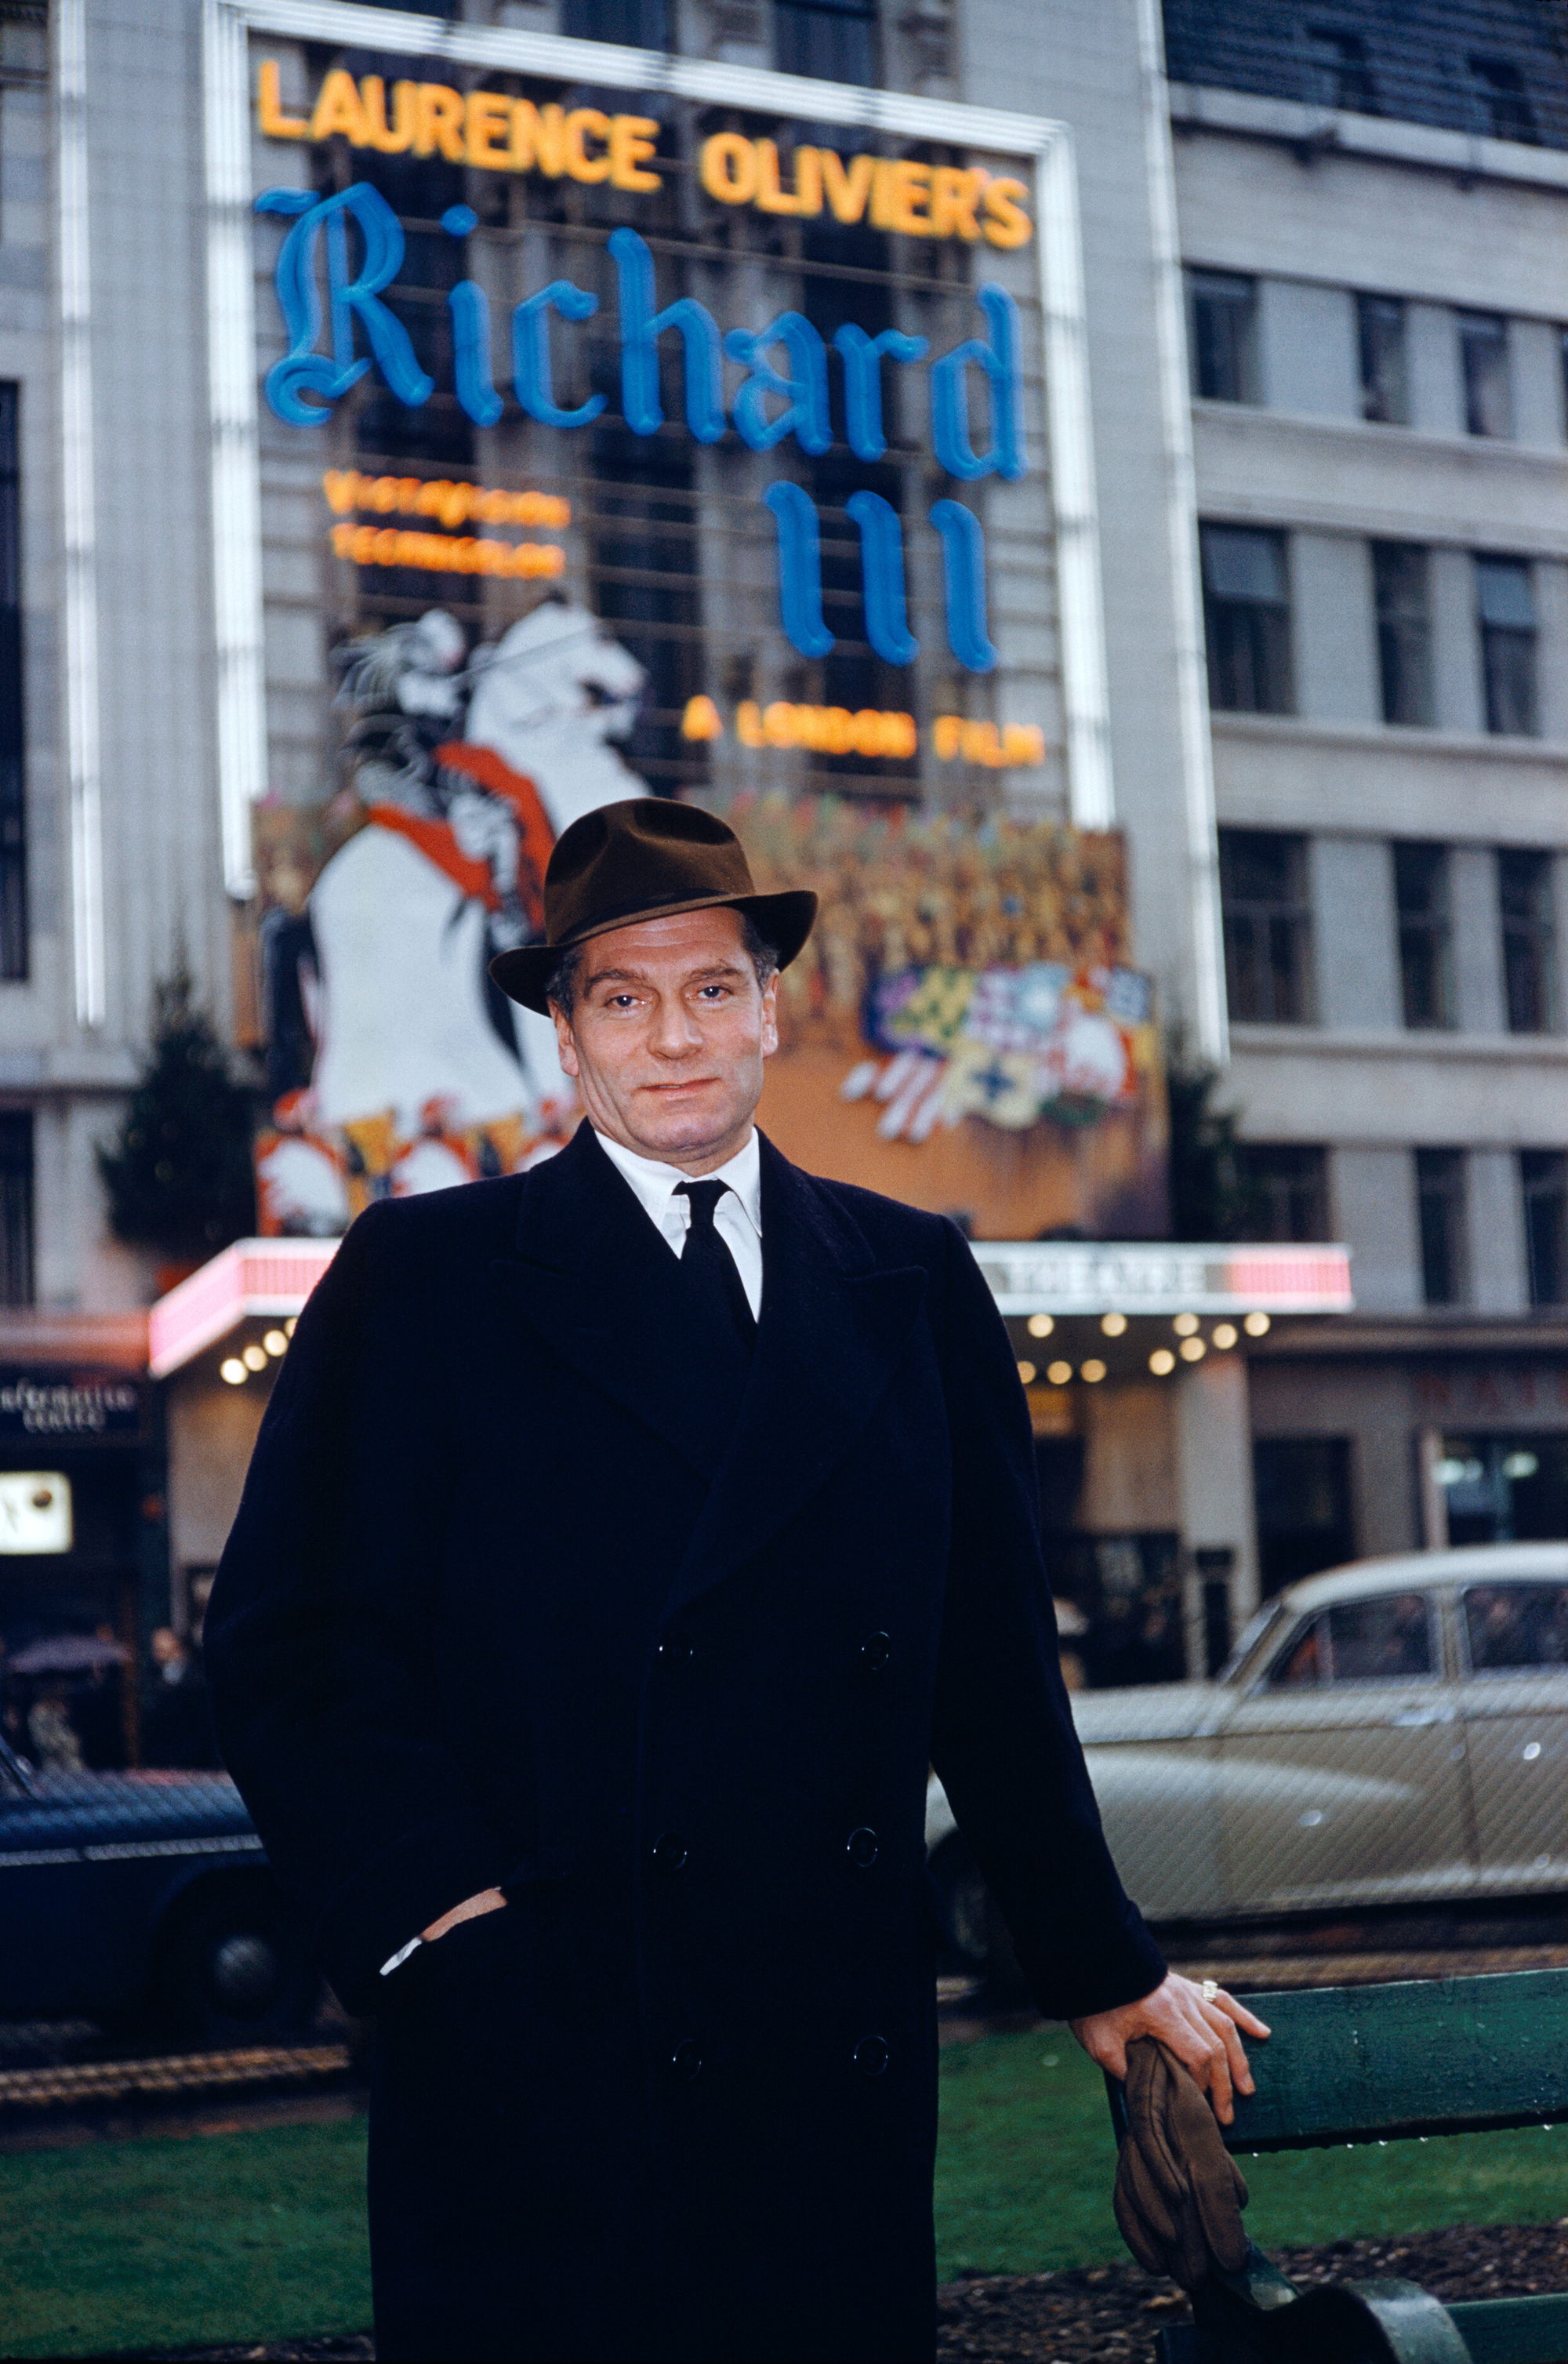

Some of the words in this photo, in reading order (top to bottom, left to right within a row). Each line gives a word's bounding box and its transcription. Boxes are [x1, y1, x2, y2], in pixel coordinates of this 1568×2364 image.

[258, 60, 662, 194] LAURENCE
[700, 132, 1034, 249] OLIVIER'S
[254, 181, 1029, 481] Richard
[681, 695, 724, 743] A
[933, 714, 1047, 768] FILM
